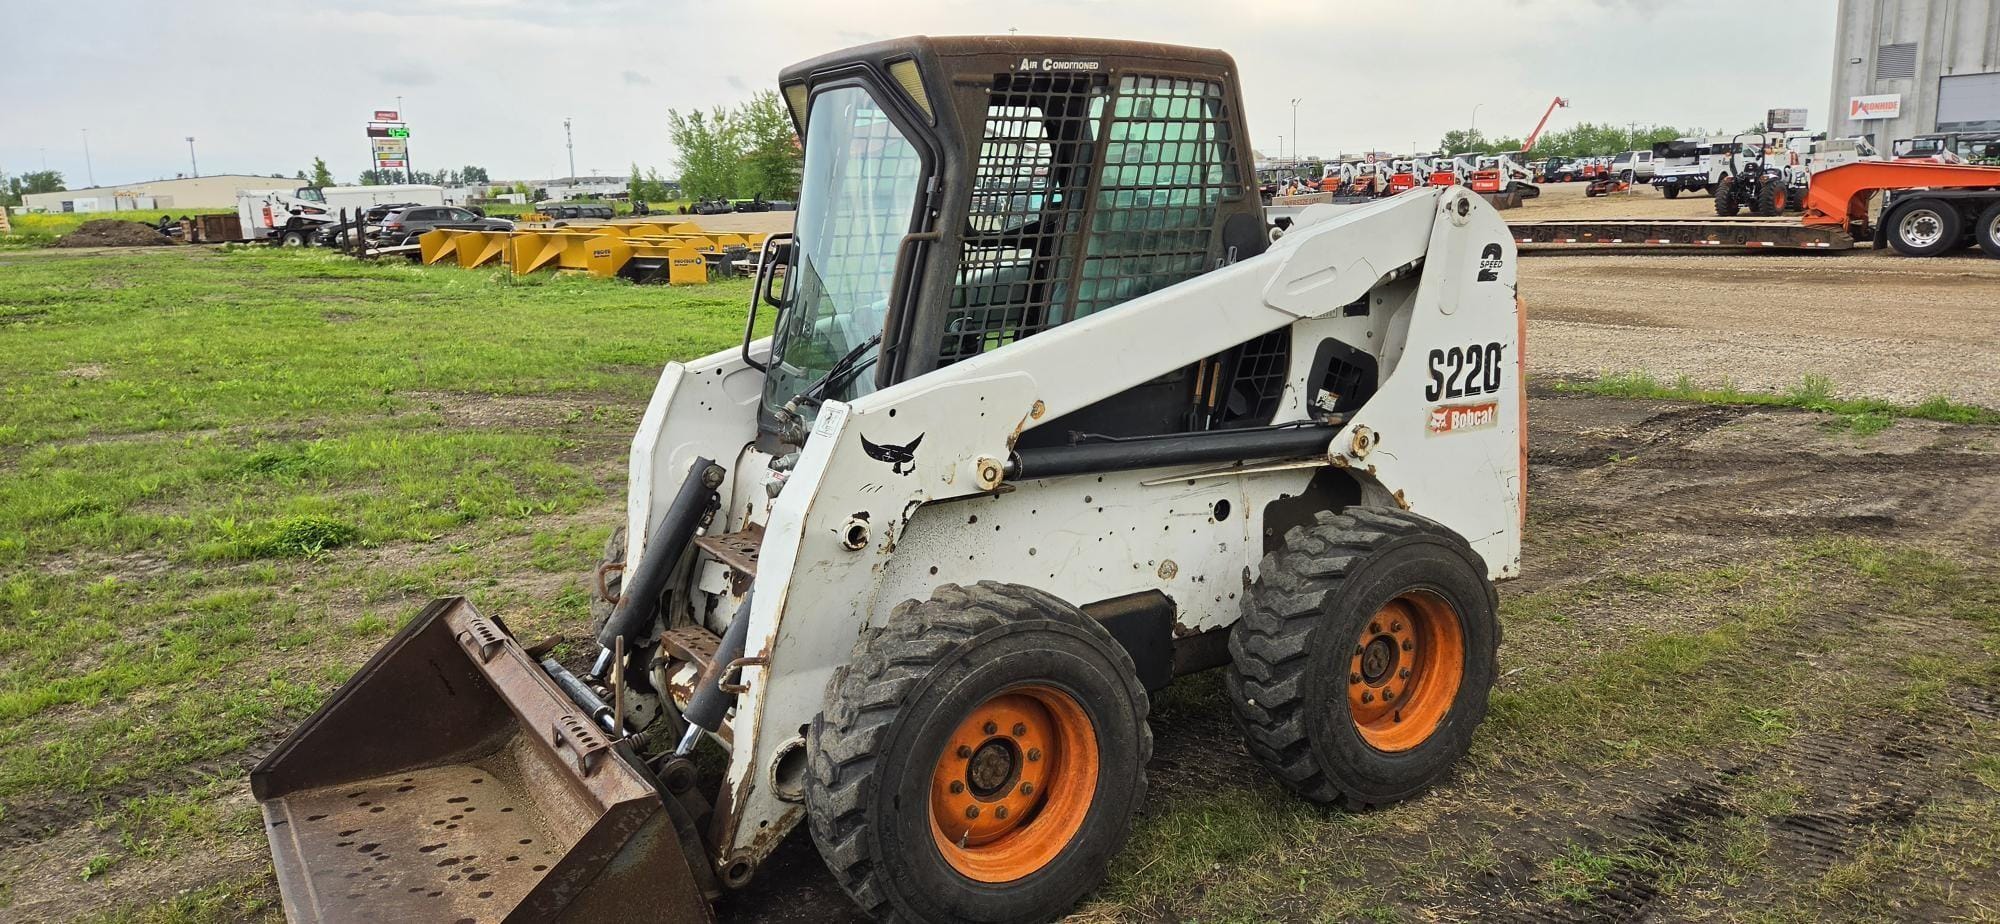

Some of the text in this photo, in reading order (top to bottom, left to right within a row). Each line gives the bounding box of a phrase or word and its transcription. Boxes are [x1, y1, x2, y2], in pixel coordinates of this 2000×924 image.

[1477, 243, 1502, 282] 2
[1479, 260, 1503, 269] SPEED
[1425, 342, 1502, 402] S220
[1451, 406, 1493, 430] Bobcat
